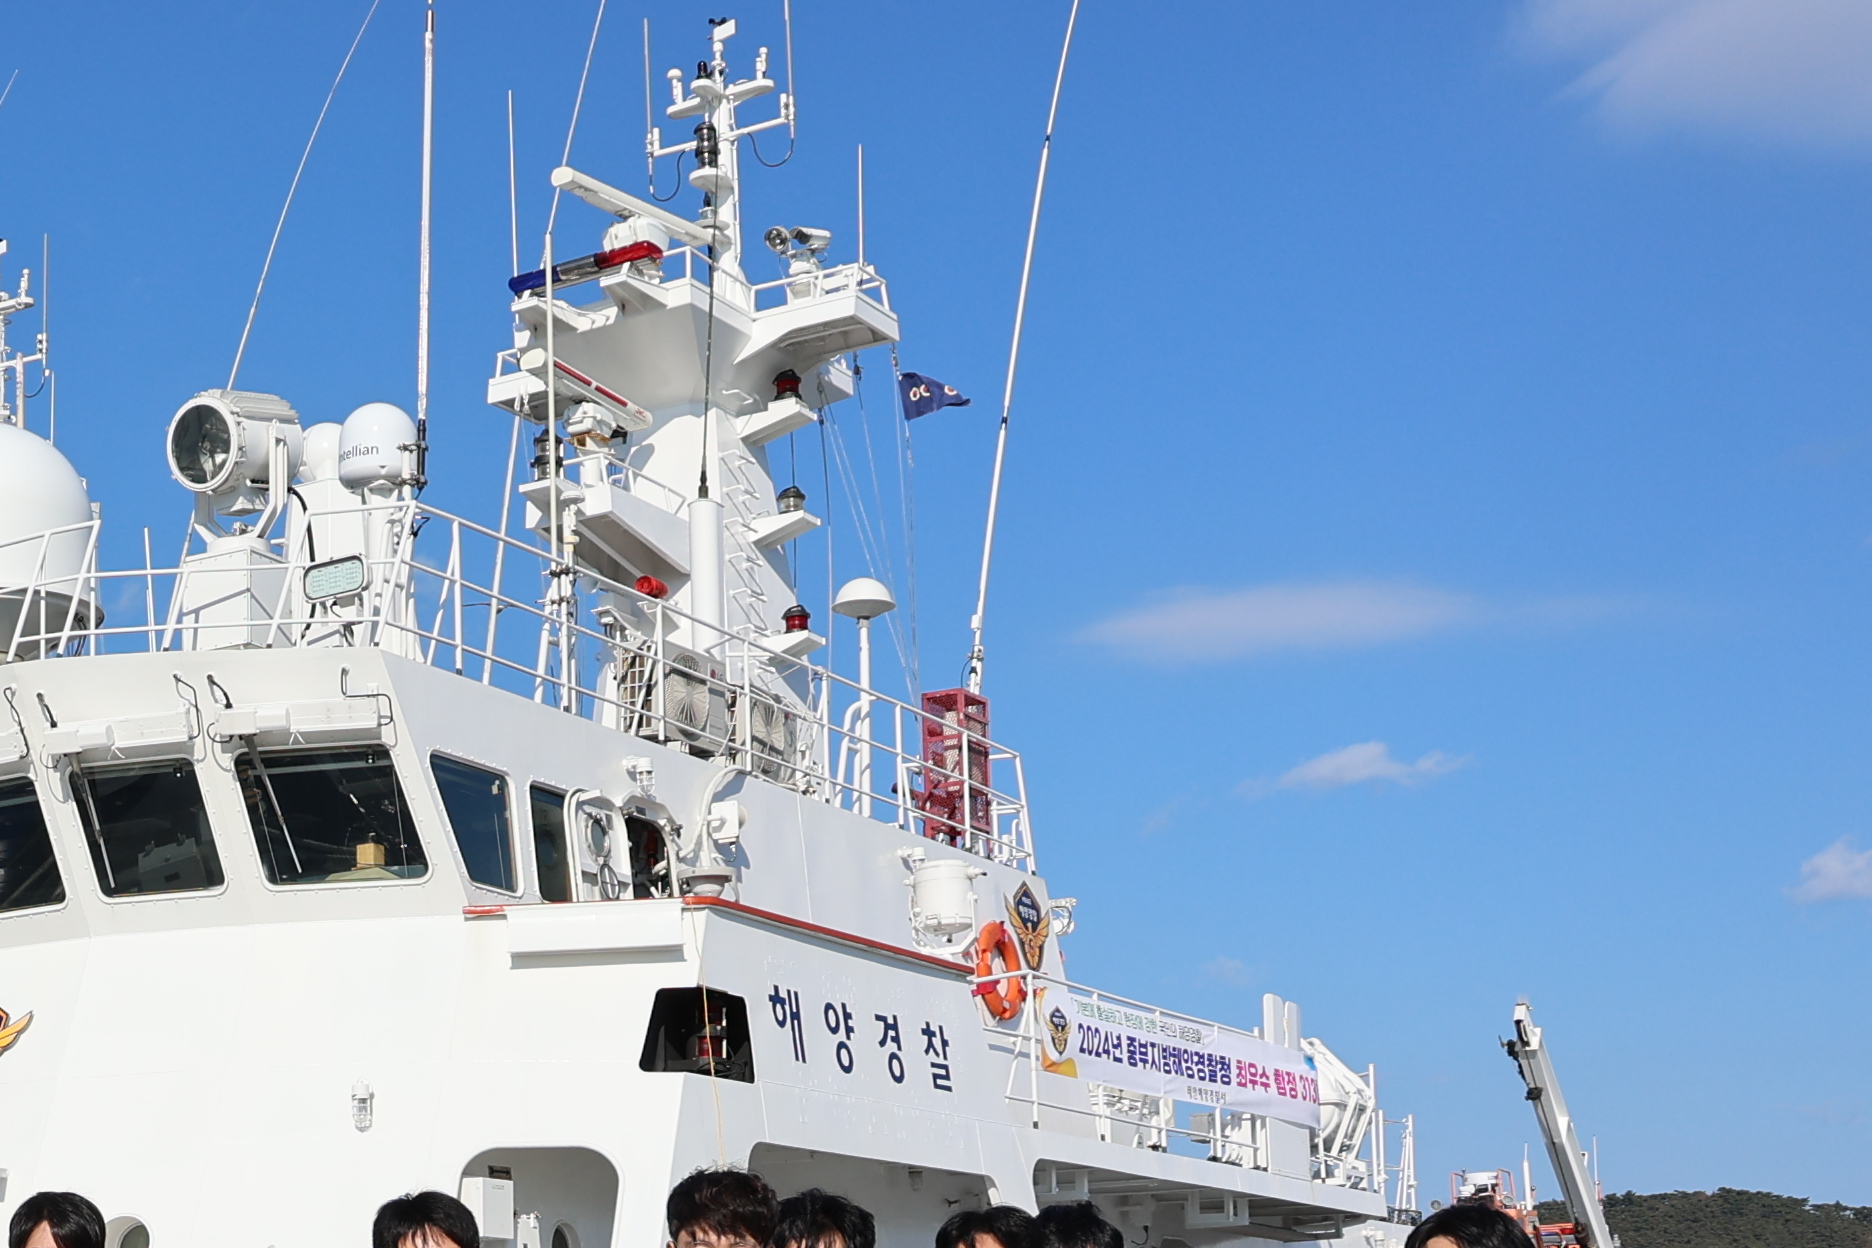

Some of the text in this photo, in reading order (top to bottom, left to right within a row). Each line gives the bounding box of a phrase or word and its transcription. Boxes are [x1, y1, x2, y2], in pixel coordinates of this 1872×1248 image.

[768, 984, 954, 1093] 해양경찰
[1078, 1022, 1124, 1064] 2024년
[1235, 1059, 1272, 1094] 최우수
[1273, 1068, 1299, 1100] 함정
[1299, 1074, 1321, 1106] 313
